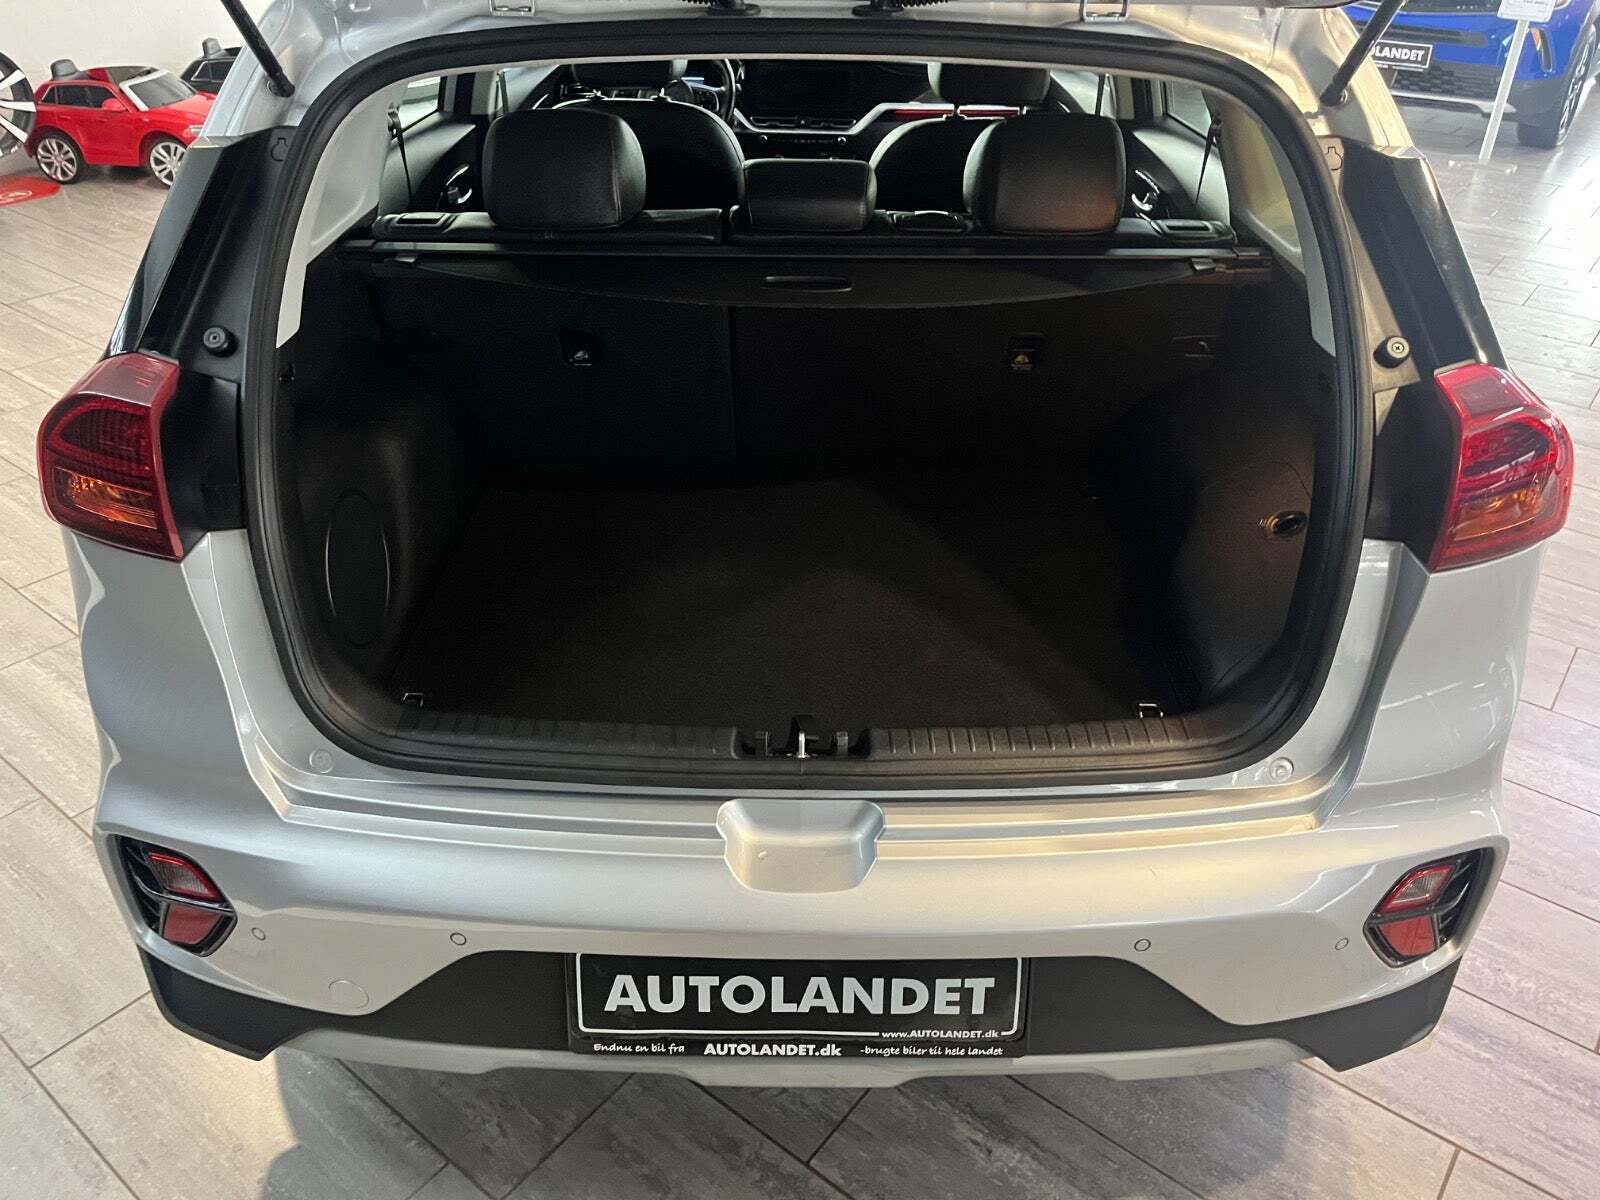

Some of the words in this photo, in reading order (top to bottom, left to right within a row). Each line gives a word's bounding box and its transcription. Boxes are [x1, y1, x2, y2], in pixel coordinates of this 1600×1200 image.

[603, 974, 996, 1015] AUTOLANDET
[881, 1029, 999, 1039] www.AUTOLANDET.dk
[593, 1043, 633, 1052] Endnu
[635, 1045, 649, 1053] en
[651, 1043, 667, 1053] bil
[668, 1043, 685, 1055] fra
[703, 1043, 842, 1057] AUTOLANDET.dk
[902, 1045, 928, 1056] biler
[929, 1045, 943, 1055] til
[945, 1046, 966, 1056] hele
[967, 1046, 1003, 1056] landet
